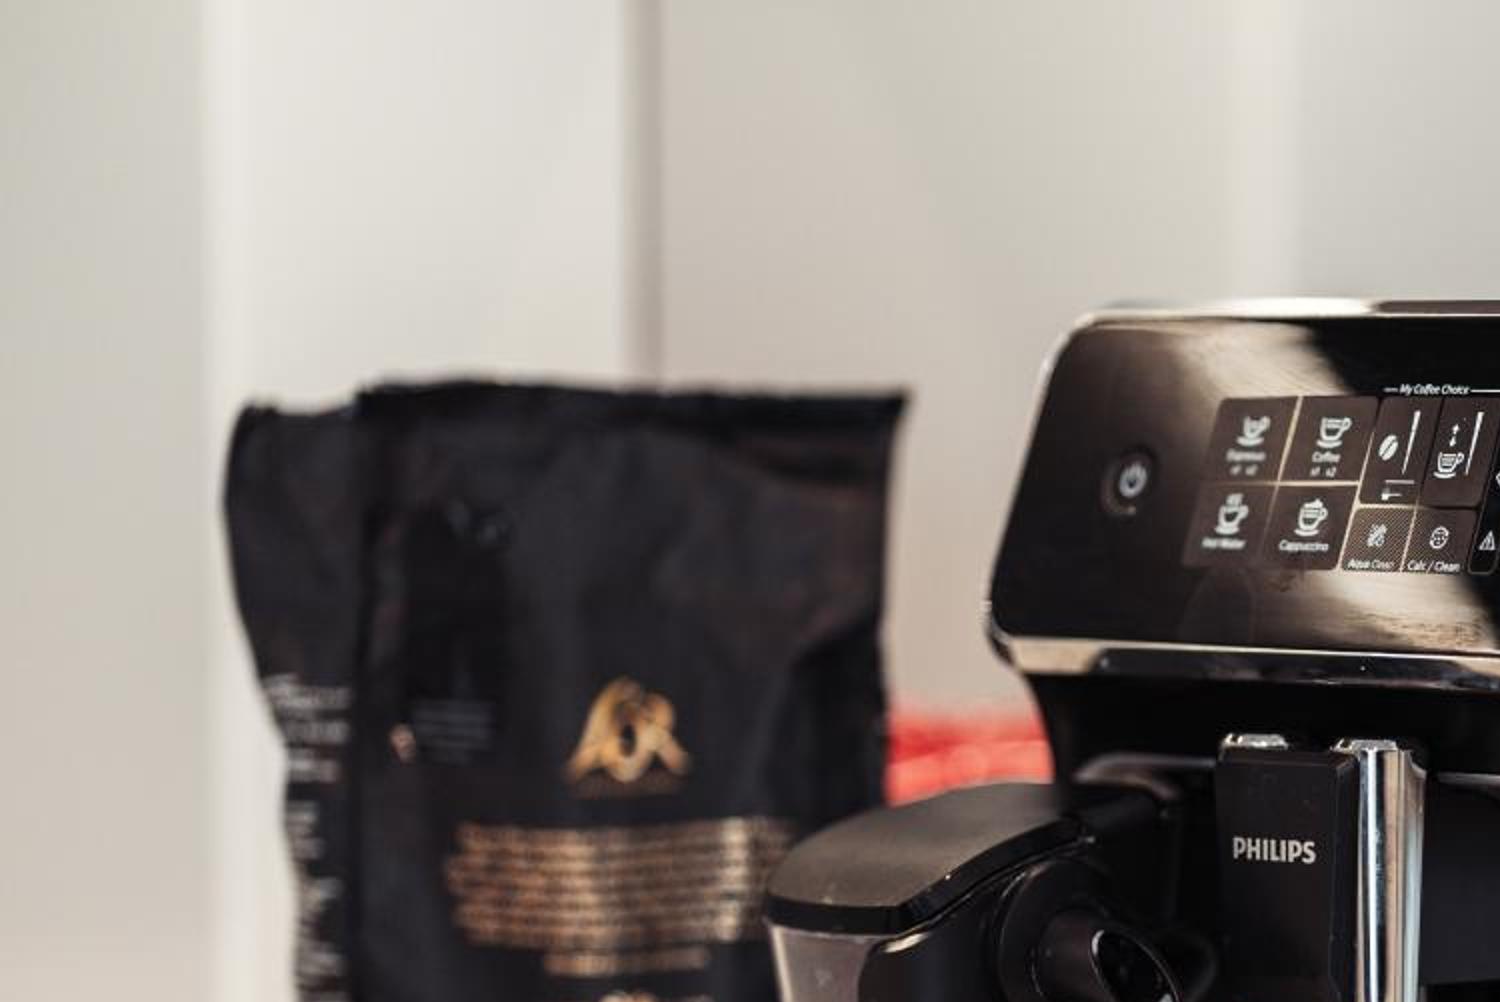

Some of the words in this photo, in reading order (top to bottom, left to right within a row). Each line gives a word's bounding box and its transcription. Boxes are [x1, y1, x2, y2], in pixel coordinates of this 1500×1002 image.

[1400, 383, 1412, 396] My
[1413, 383, 1440, 395] Coffee
[1441, 383, 1470, 395] Choice
[1407, 559, 1426, 571] Calc
[1434, 560, 1460, 573] Clean
[1232, 836, 1317, 864] PHILIPS
